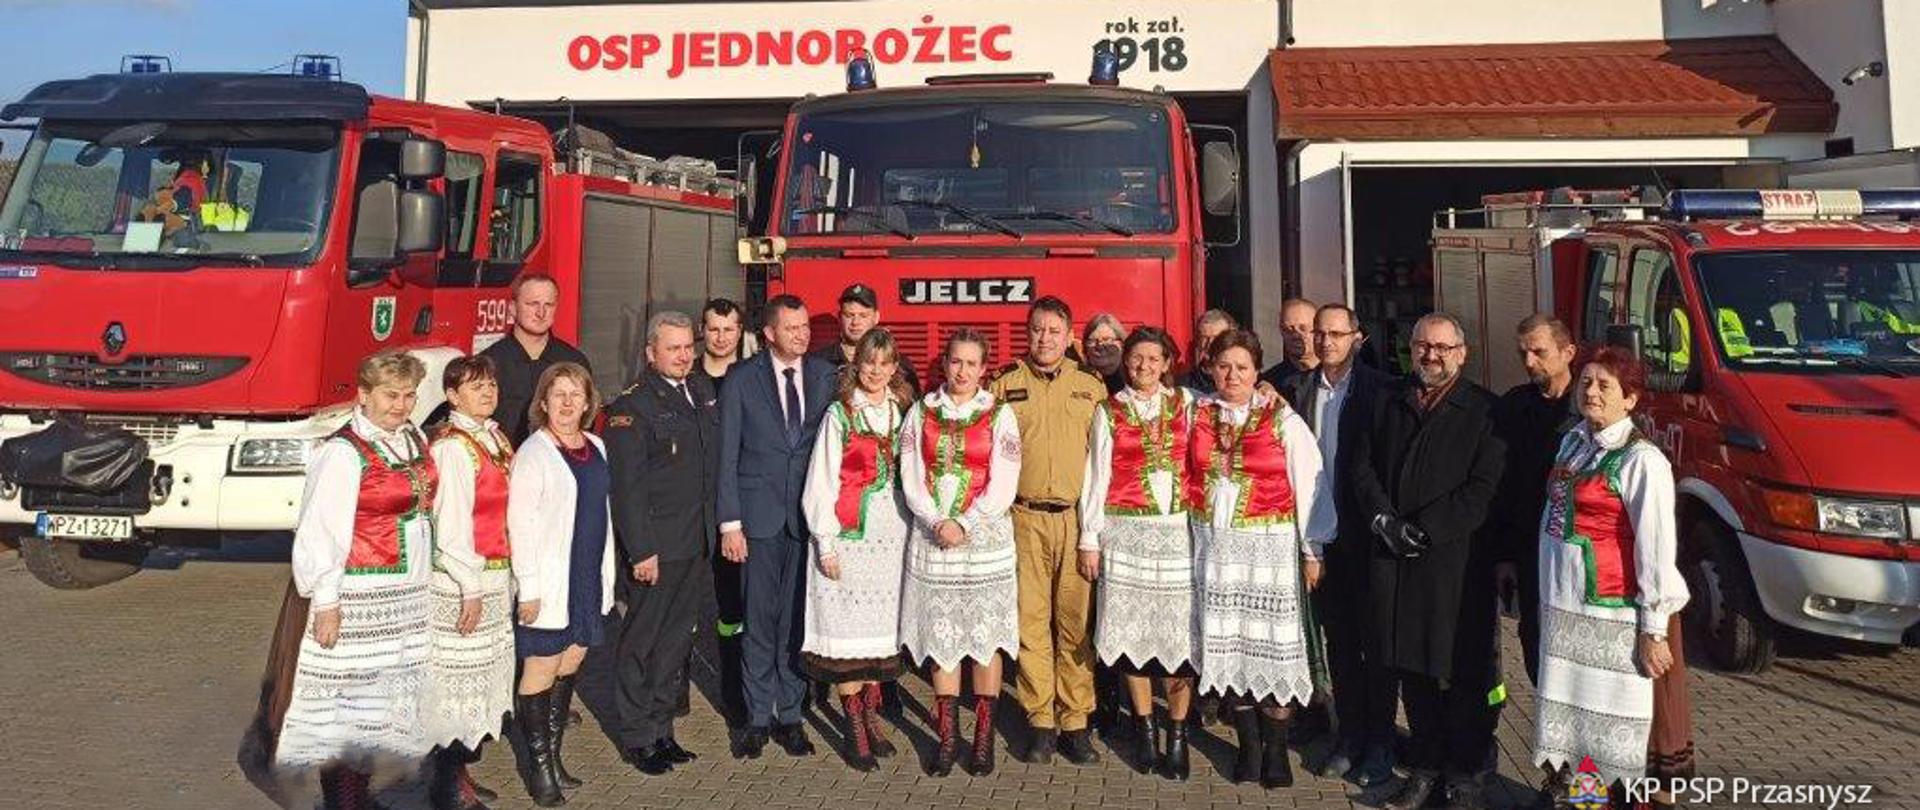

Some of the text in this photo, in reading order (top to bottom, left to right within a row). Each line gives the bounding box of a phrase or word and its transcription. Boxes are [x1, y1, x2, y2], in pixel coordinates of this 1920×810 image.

[1105, 16, 1184, 33] rok zał.
[567, 15, 1012, 79] OSP JEDNOROŻEC
[905, 280, 1030, 304] JELCZ
[47, 516, 128, 536] WPZ 13271
